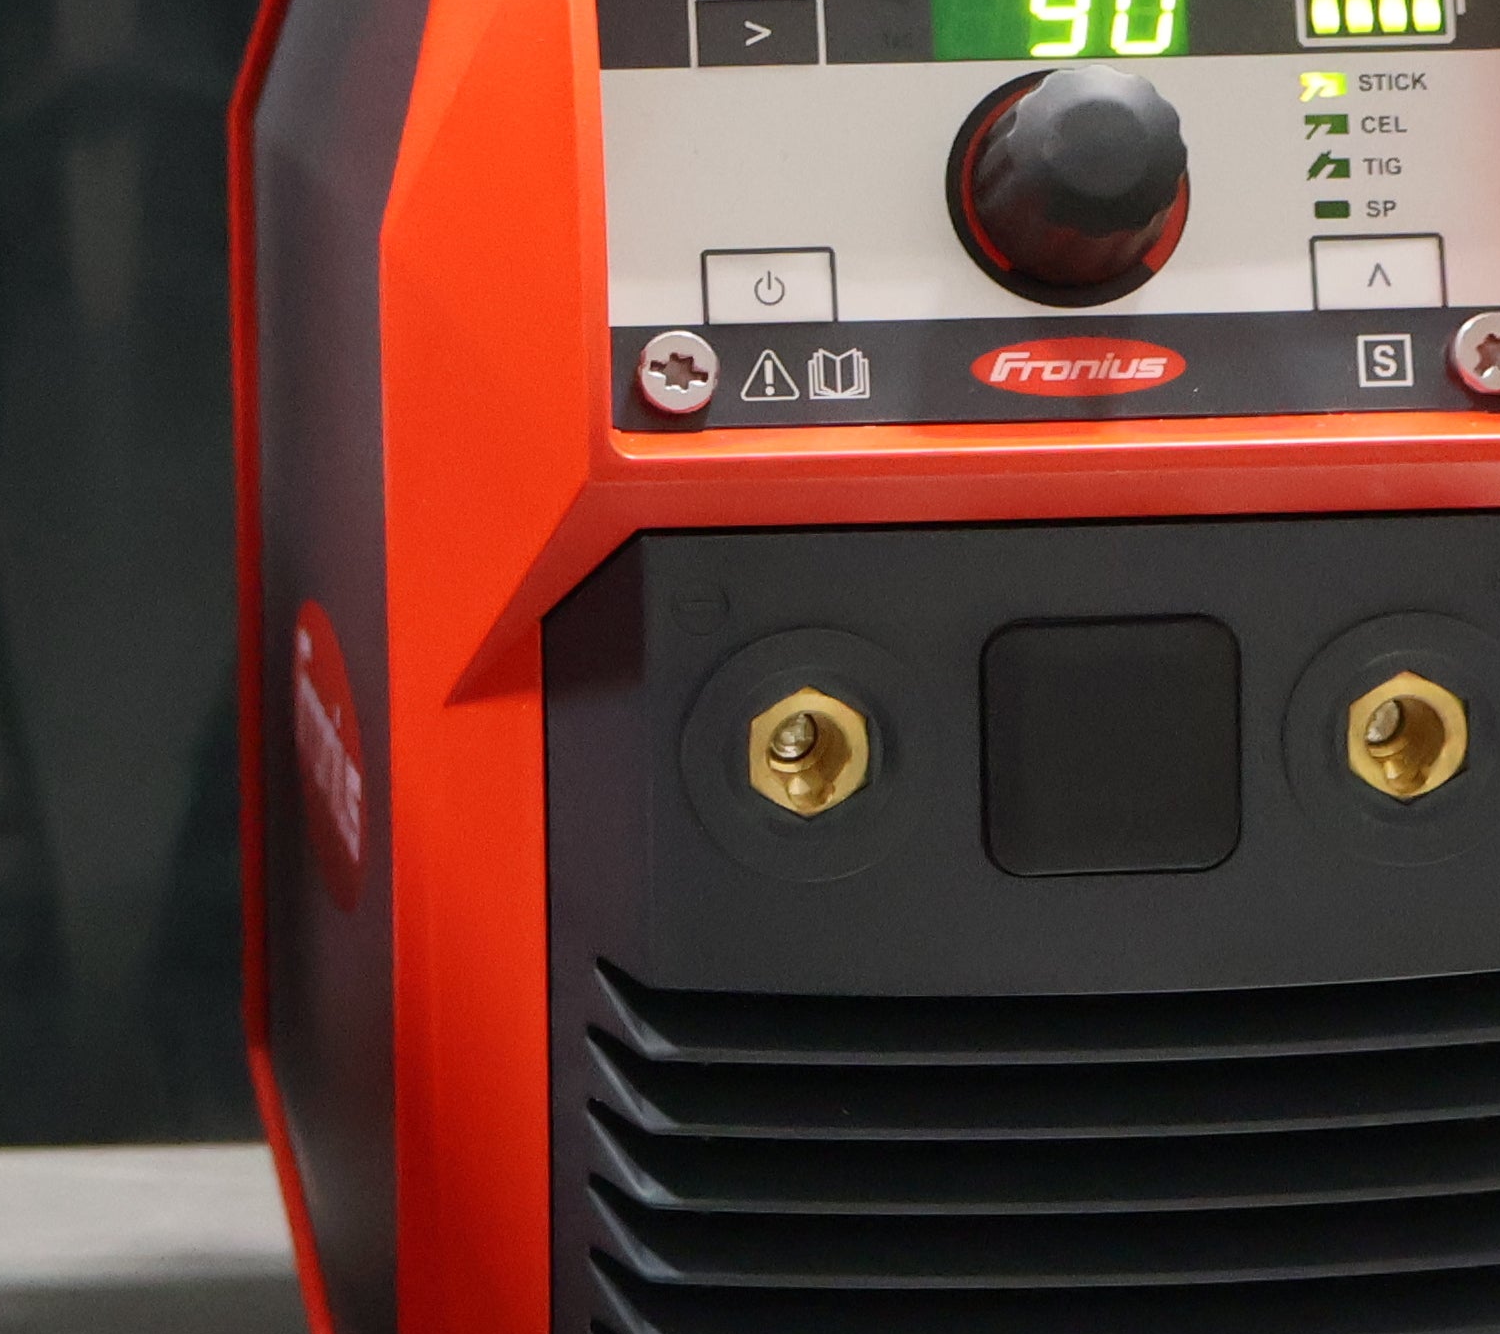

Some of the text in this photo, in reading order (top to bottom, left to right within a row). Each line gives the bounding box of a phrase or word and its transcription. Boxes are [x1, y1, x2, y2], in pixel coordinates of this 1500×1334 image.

[1358, 71, 1428, 94] STICK
[1360, 115, 1408, 134] CEL
[1362, 157, 1403, 176] TIG
[1366, 200, 1397, 218] SP
[989, 351, 1168, 382] Fronius
[1372, 344, 1398, 378] S
